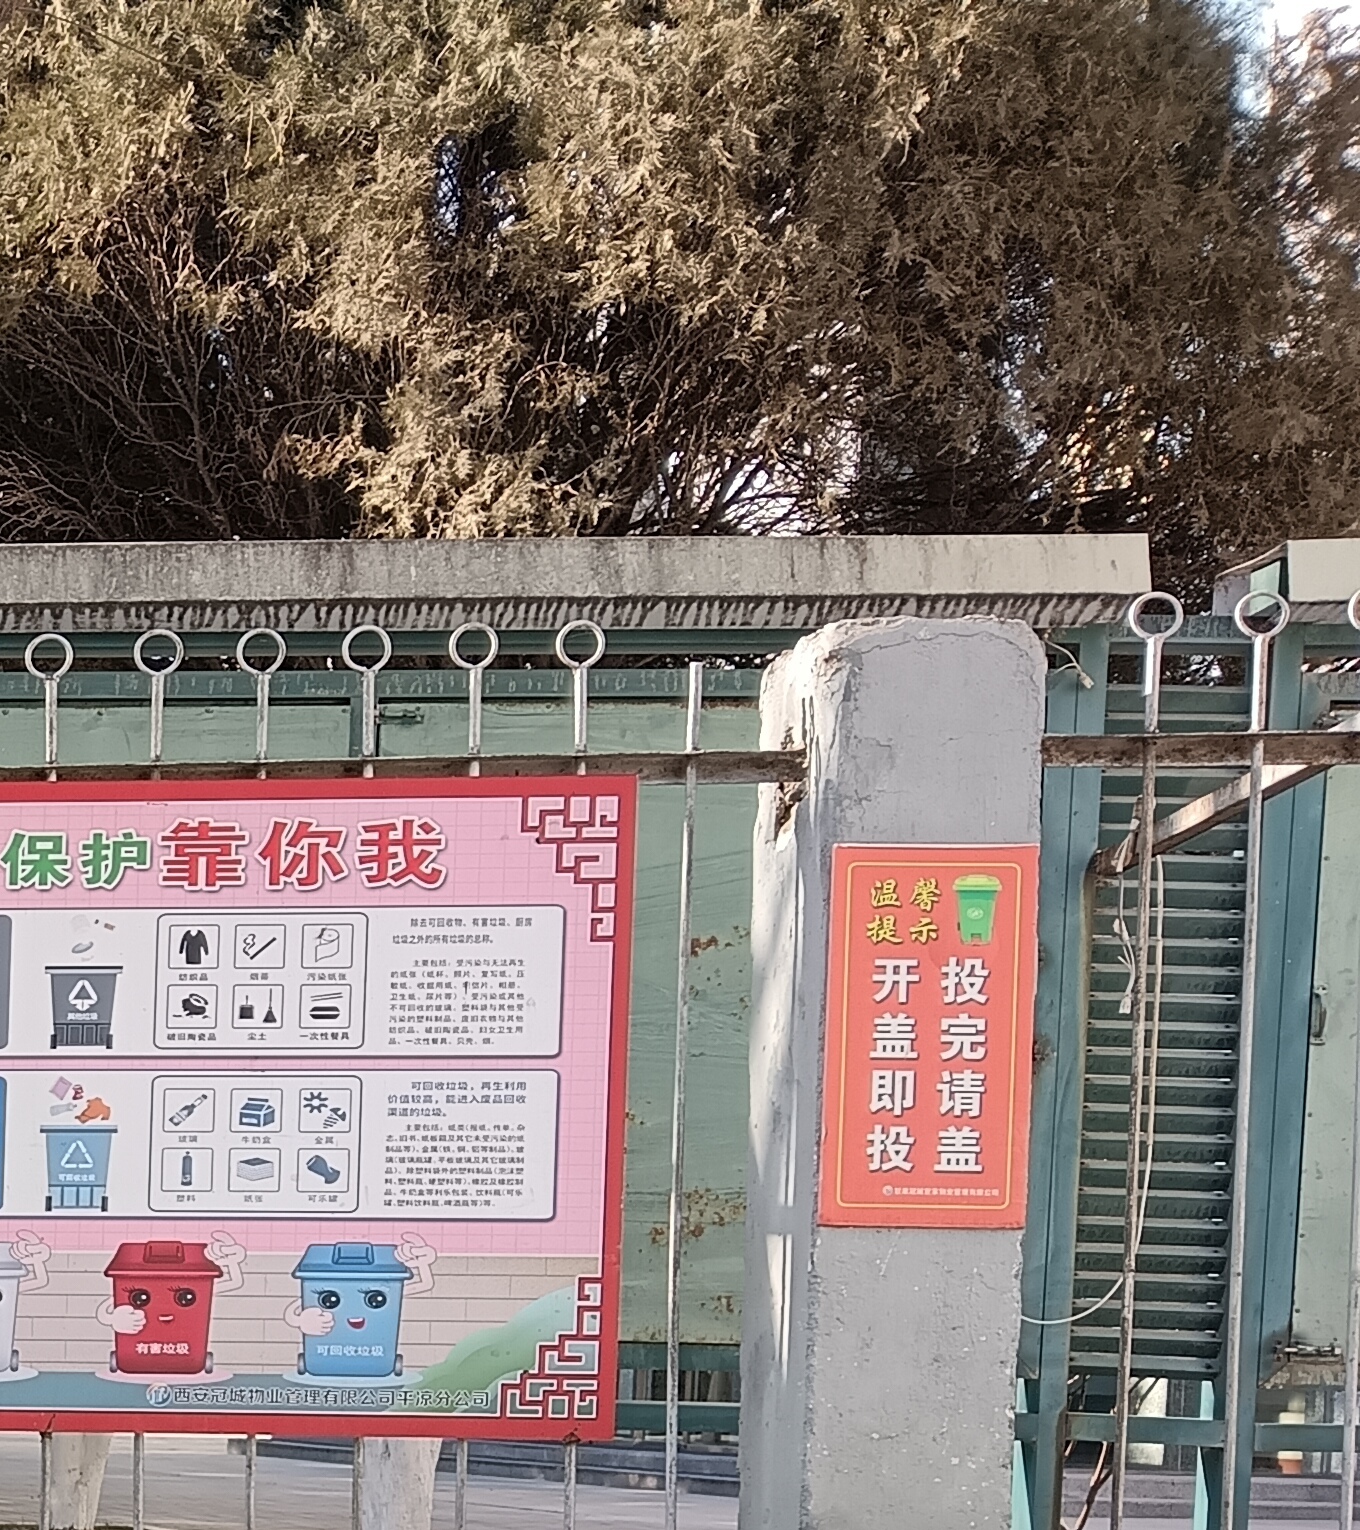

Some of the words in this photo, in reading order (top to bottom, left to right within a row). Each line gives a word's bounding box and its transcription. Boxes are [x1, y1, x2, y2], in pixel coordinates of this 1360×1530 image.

[870, 878, 942, 911] 温馨
[866, 917, 940, 945] 提示
[247, 1032, 267, 1041] 尘土
[299, 1032, 350, 1041] 一次性餐具
[866, 957, 921, 1173] 开盖即投
[933, 956, 990, 1174] 投完请盖
[411, 1081, 527, 1091] 可回收垃圾，再生利用
[387, 1094, 527, 1104] 价值较高，能进入废品回收
[241, 1135, 271, 1144] 牛奶盒
[315, 1136, 334, 1144] 金属
[135, 1342, 190, 1356] 有害垃圾
[316, 1344, 384, 1358] 可回收垃圾
[173, 1387, 490, 1408] 西安冠城物业管理有限公司平凉分公司
